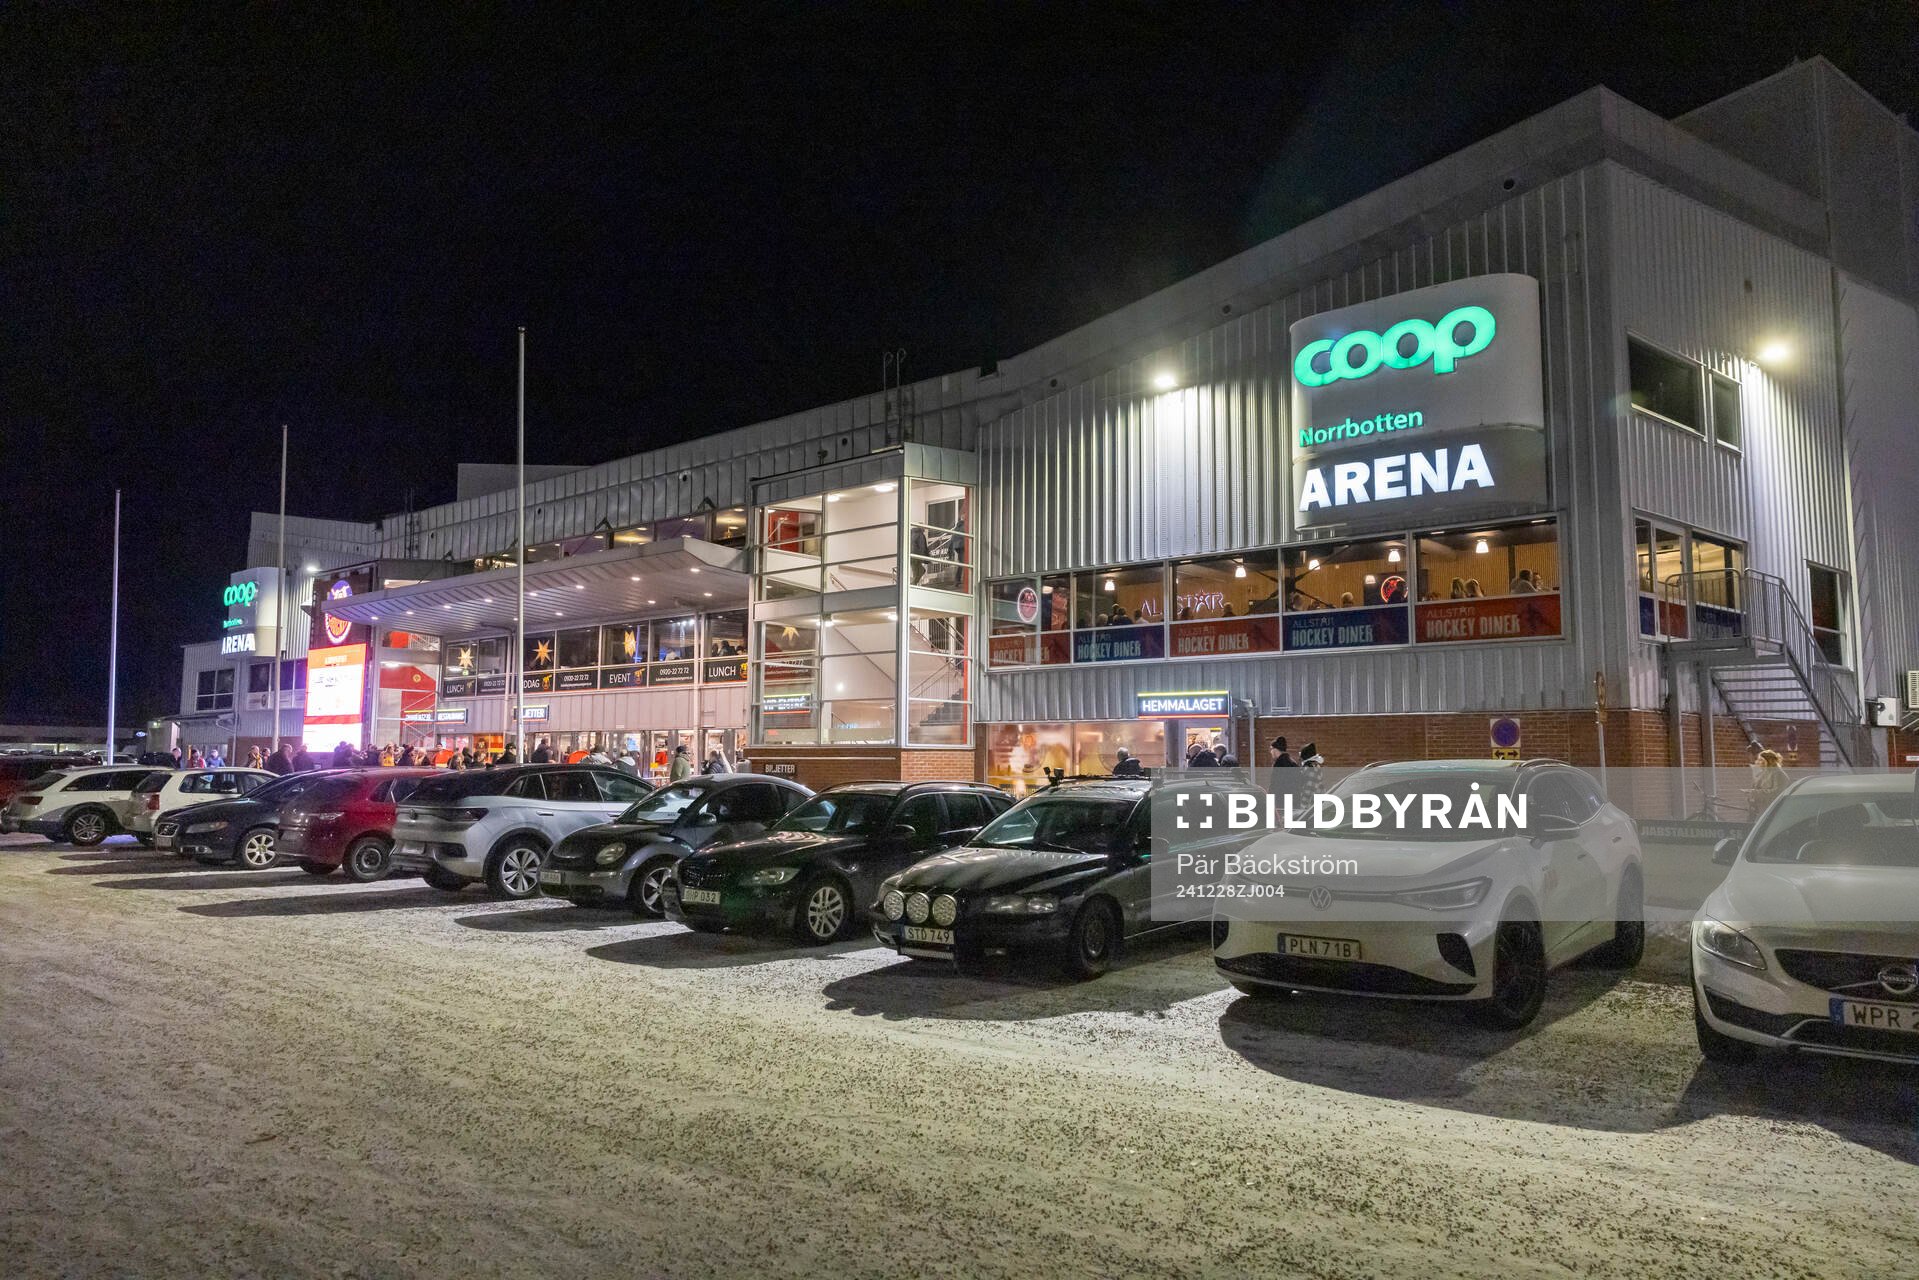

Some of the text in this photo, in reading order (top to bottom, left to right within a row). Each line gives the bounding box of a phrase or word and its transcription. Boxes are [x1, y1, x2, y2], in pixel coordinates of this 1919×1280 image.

[1294, 305, 1496, 387] coop
[1299, 409, 1424, 447] Norrbotten
[1299, 443, 1496, 512] ARENA
[1292, 624, 1373, 647] HOCKEY DINER
[1426, 614, 1520, 640] HOCKEY DINER
[221, 633, 256, 655] ARENA
[1078, 640, 1142, 660] HOCKEY DINER
[1178, 632, 1249, 654] HOCKEY DINER
[609, 673, 631, 684] EVENT
[708, 666, 737, 677] LUNCH
[446, 684, 464, 693] LUNCH
[523, 679, 540, 688] DDAG
[1142, 697, 1224, 712] HEMMALAGET
[1290, 938, 1317, 954] PLN
[1852, 1004, 1902, 1028] WPR
